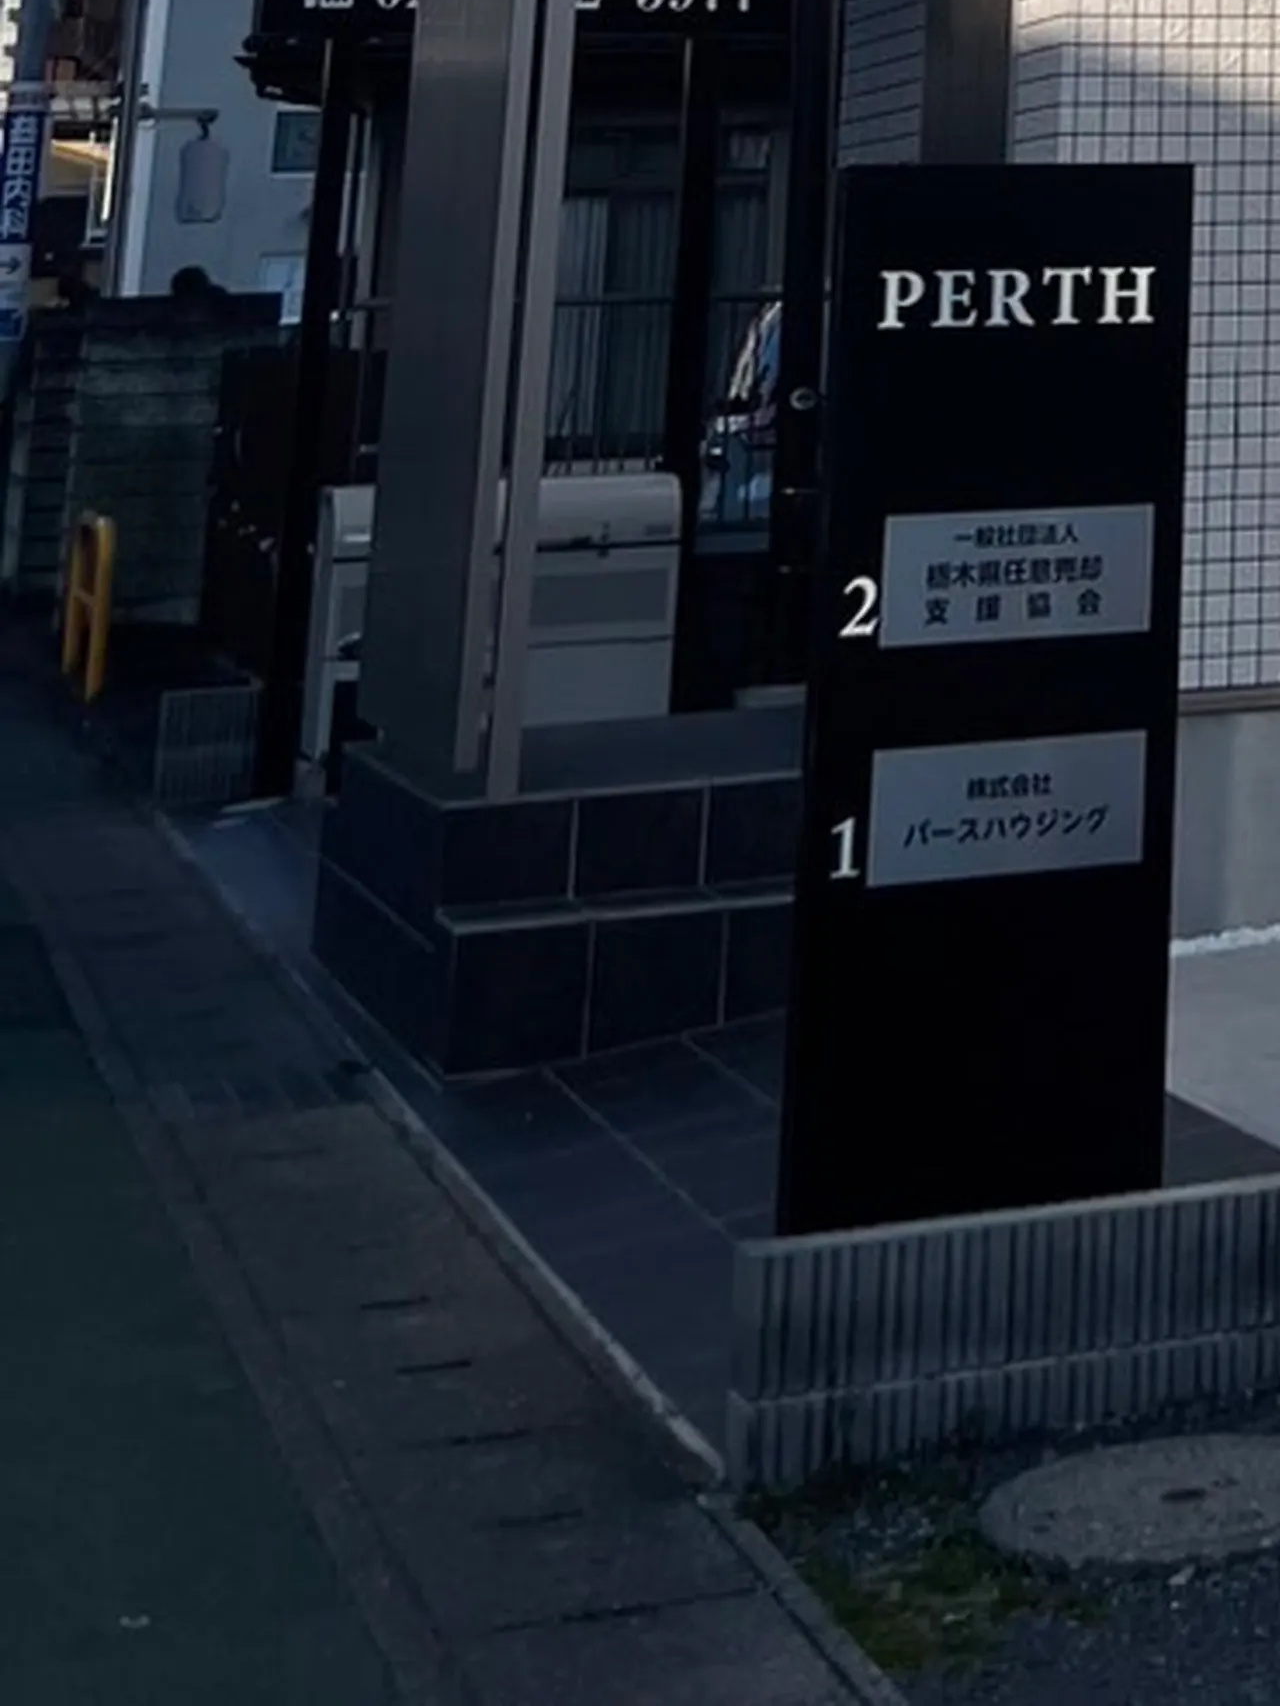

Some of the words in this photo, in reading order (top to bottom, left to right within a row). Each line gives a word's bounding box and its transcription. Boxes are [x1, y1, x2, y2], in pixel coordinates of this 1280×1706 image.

[876, 266, 1156, 330] PERTH
[953, 523, 1079, 548] 一般社団法人
[839, 575, 879, 637] 2
[966, 772, 1053, 801] 株式会社
[830, 816, 860, 879] 1
[903, 804, 1111, 848] パースハウジング
